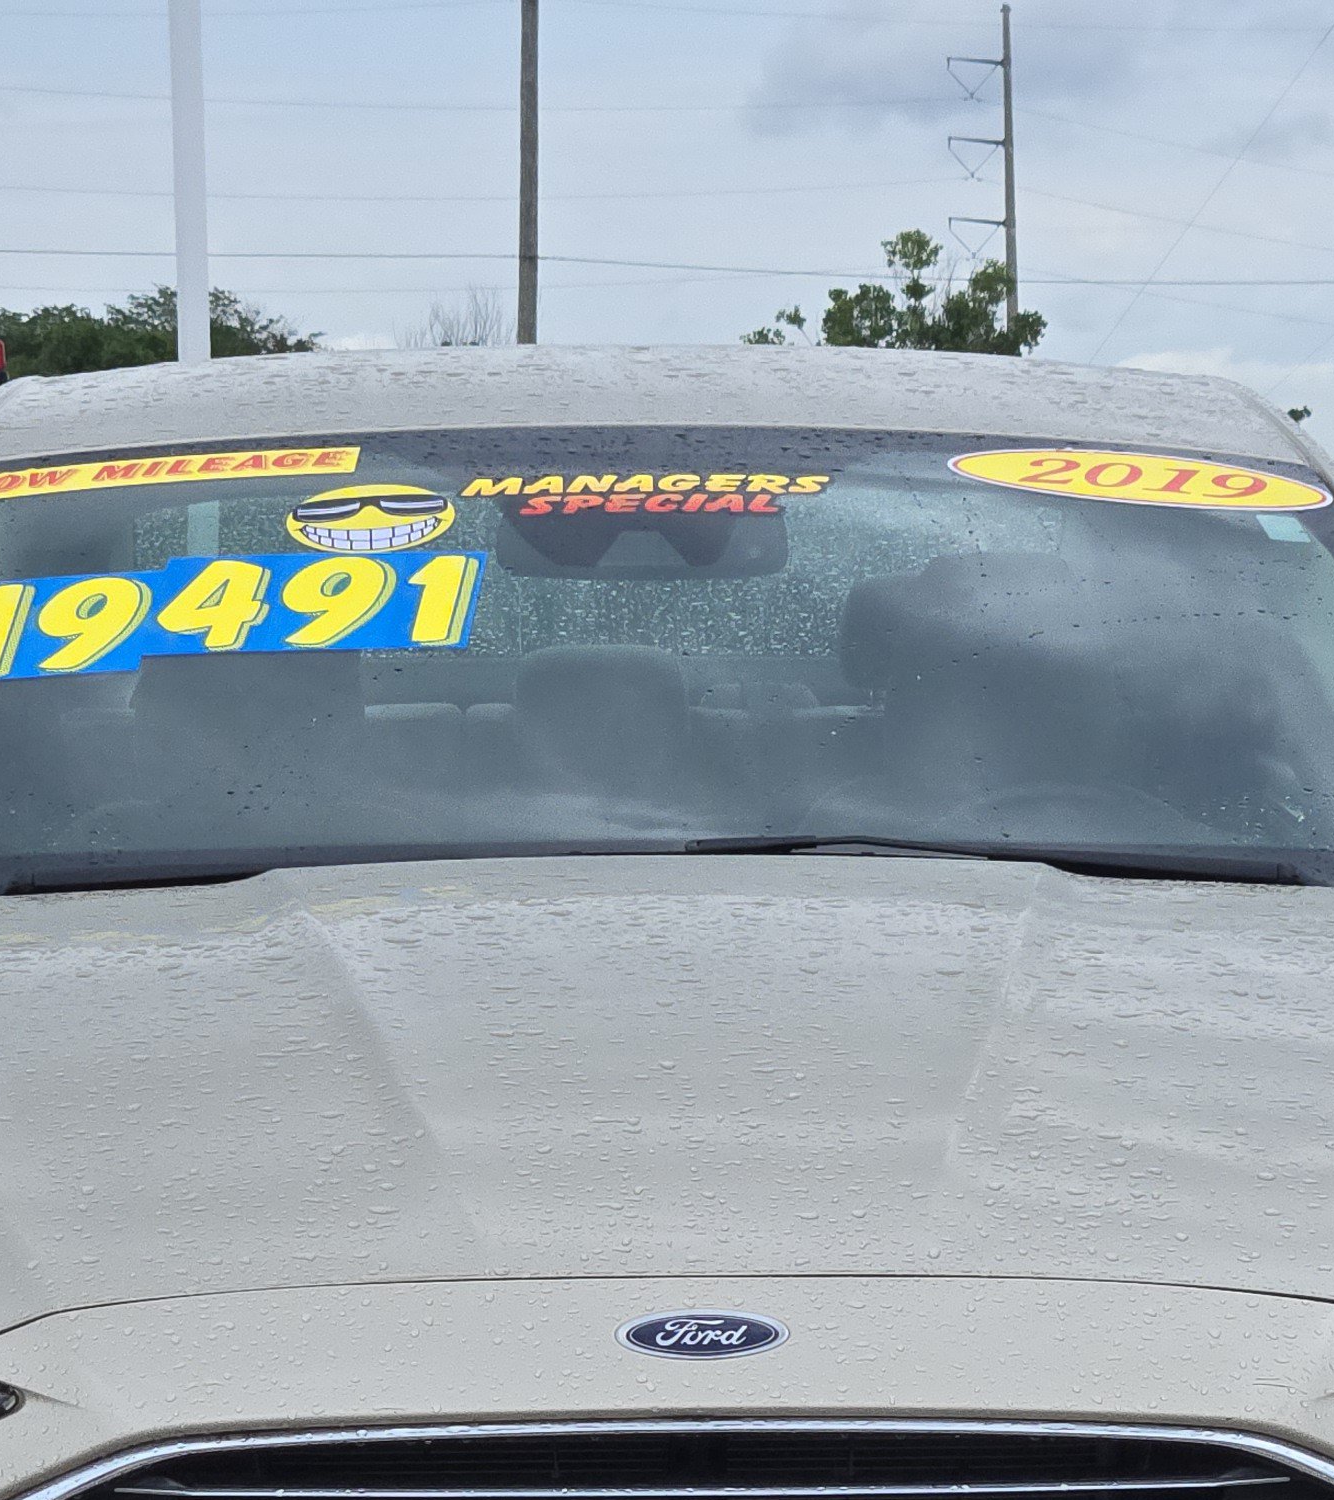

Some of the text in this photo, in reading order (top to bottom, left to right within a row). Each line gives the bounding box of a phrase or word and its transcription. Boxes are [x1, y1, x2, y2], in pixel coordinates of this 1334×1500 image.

[91, 450, 351, 481] MILEAGE
[1018, 458, 1268, 498] 2019
[461, 474, 830, 496] MANAGERS
[519, 494, 781, 516] SPECIAL
[655, 1319, 747, 1346] Ford
